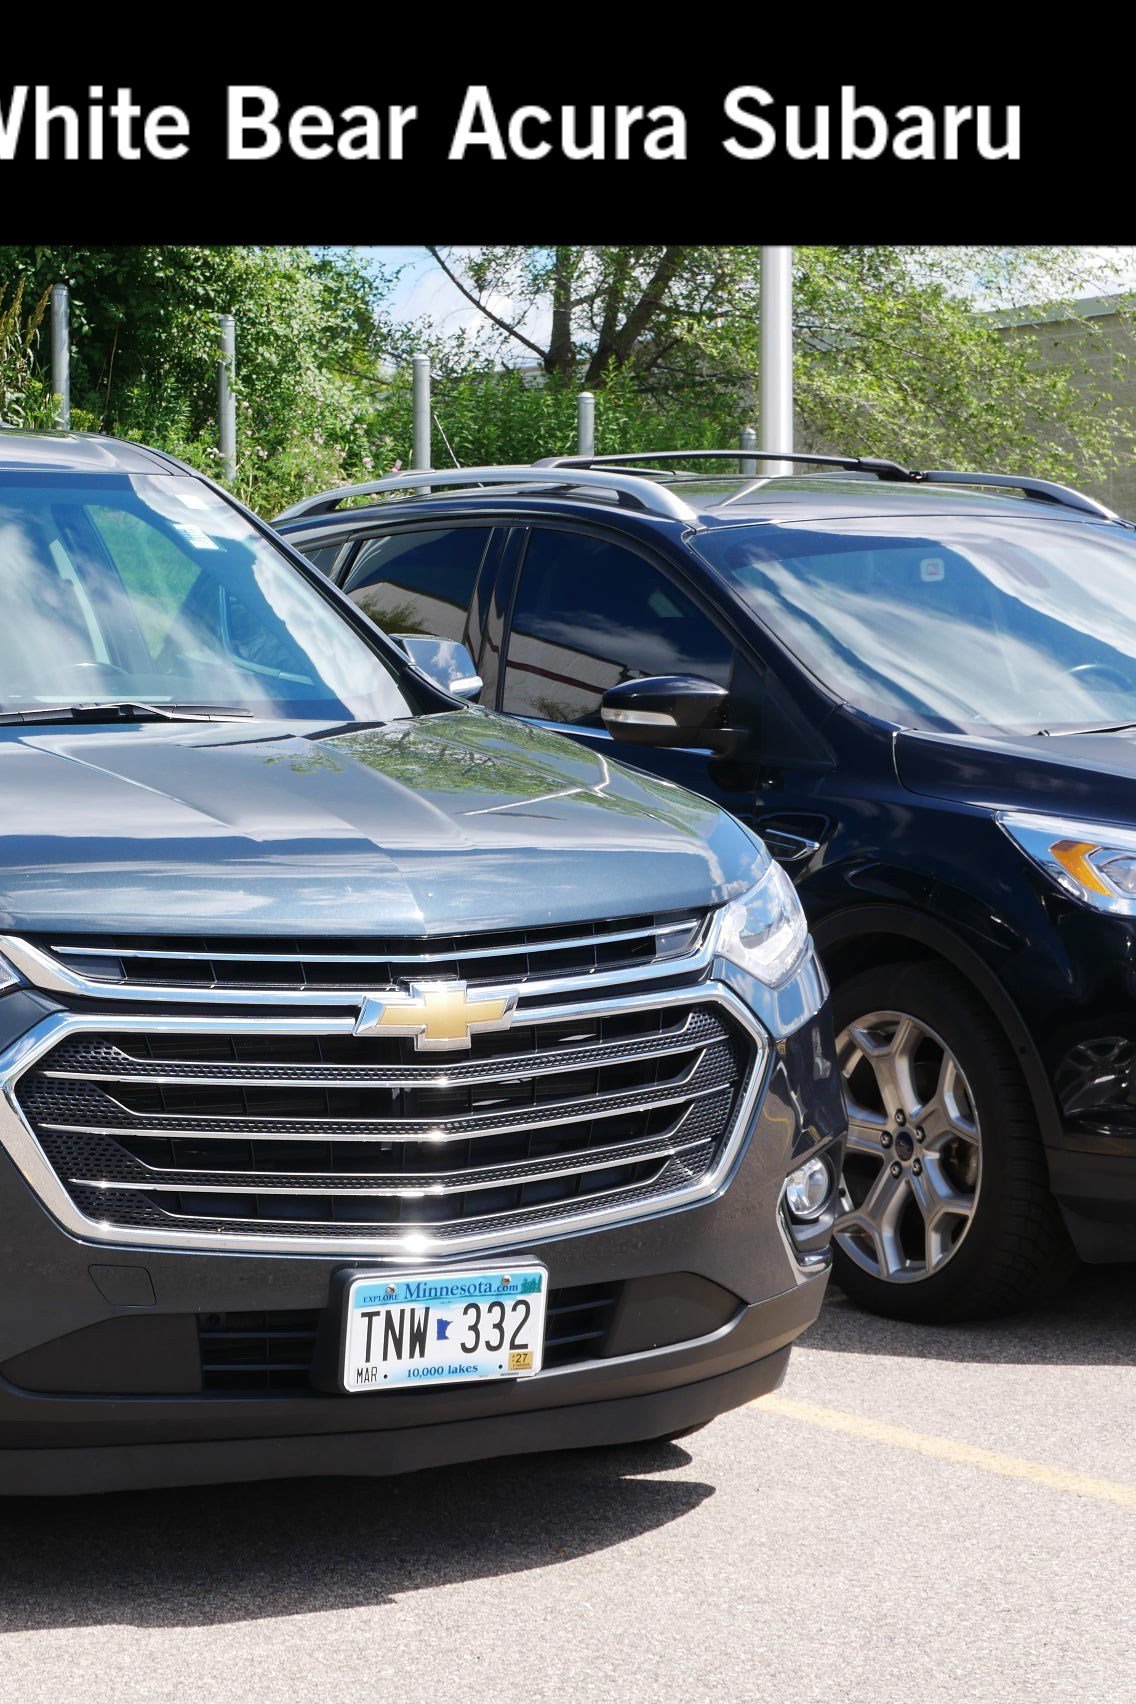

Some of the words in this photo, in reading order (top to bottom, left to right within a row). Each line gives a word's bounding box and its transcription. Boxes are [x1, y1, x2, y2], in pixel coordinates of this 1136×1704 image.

[363, 1294, 399, 1304] EXPLORE
[404, 1282, 519, 1300] Minnesota.com
[360, 1306, 431, 1363] TNW
[460, 1299, 531, 1354] 332
[515, 1353, 529, 1363] 27
[356, 1366, 378, 1385] MAR
[406, 1366, 445, 1379] 10,000
[447, 1364, 479, 1375] lakes
